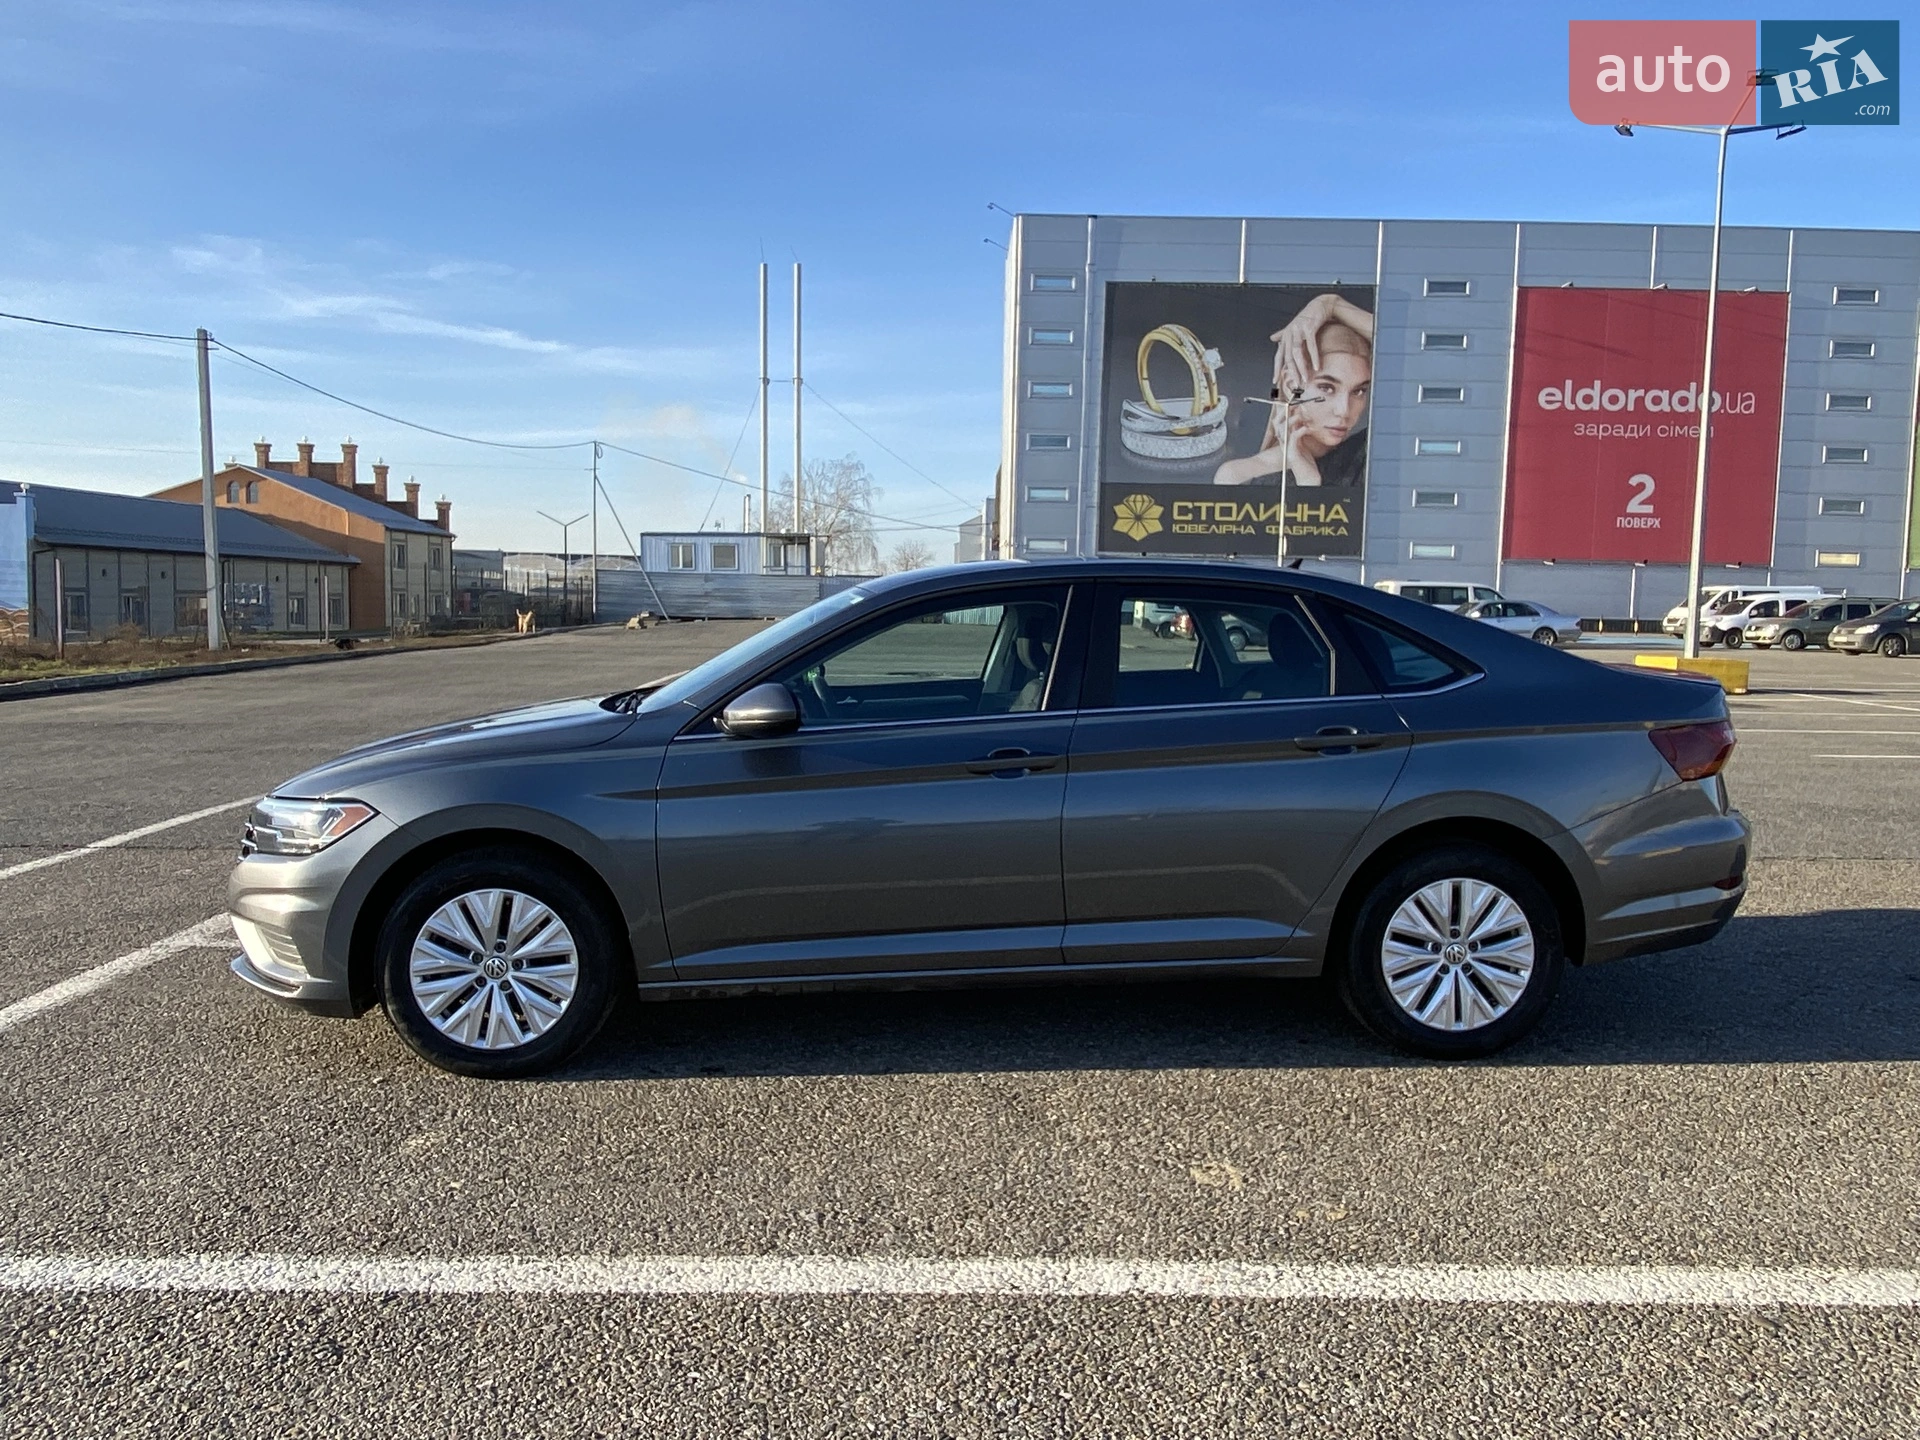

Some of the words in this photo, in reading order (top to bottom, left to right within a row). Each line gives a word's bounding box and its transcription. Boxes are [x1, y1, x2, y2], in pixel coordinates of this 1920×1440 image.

[1537, 379, 1756, 414] eldorado.ua
[1573, 422, 1651, 440] заради
[1626, 473, 1656, 514] 2
[1172, 501, 1350, 523] СТОЛИЧНА
[1172, 524, 1256, 535] ЮВЕЛІРНА
[1265, 525, 1348, 536] ФАБРИКА
[1616, 516, 1661, 529] ПОВЕРХ
